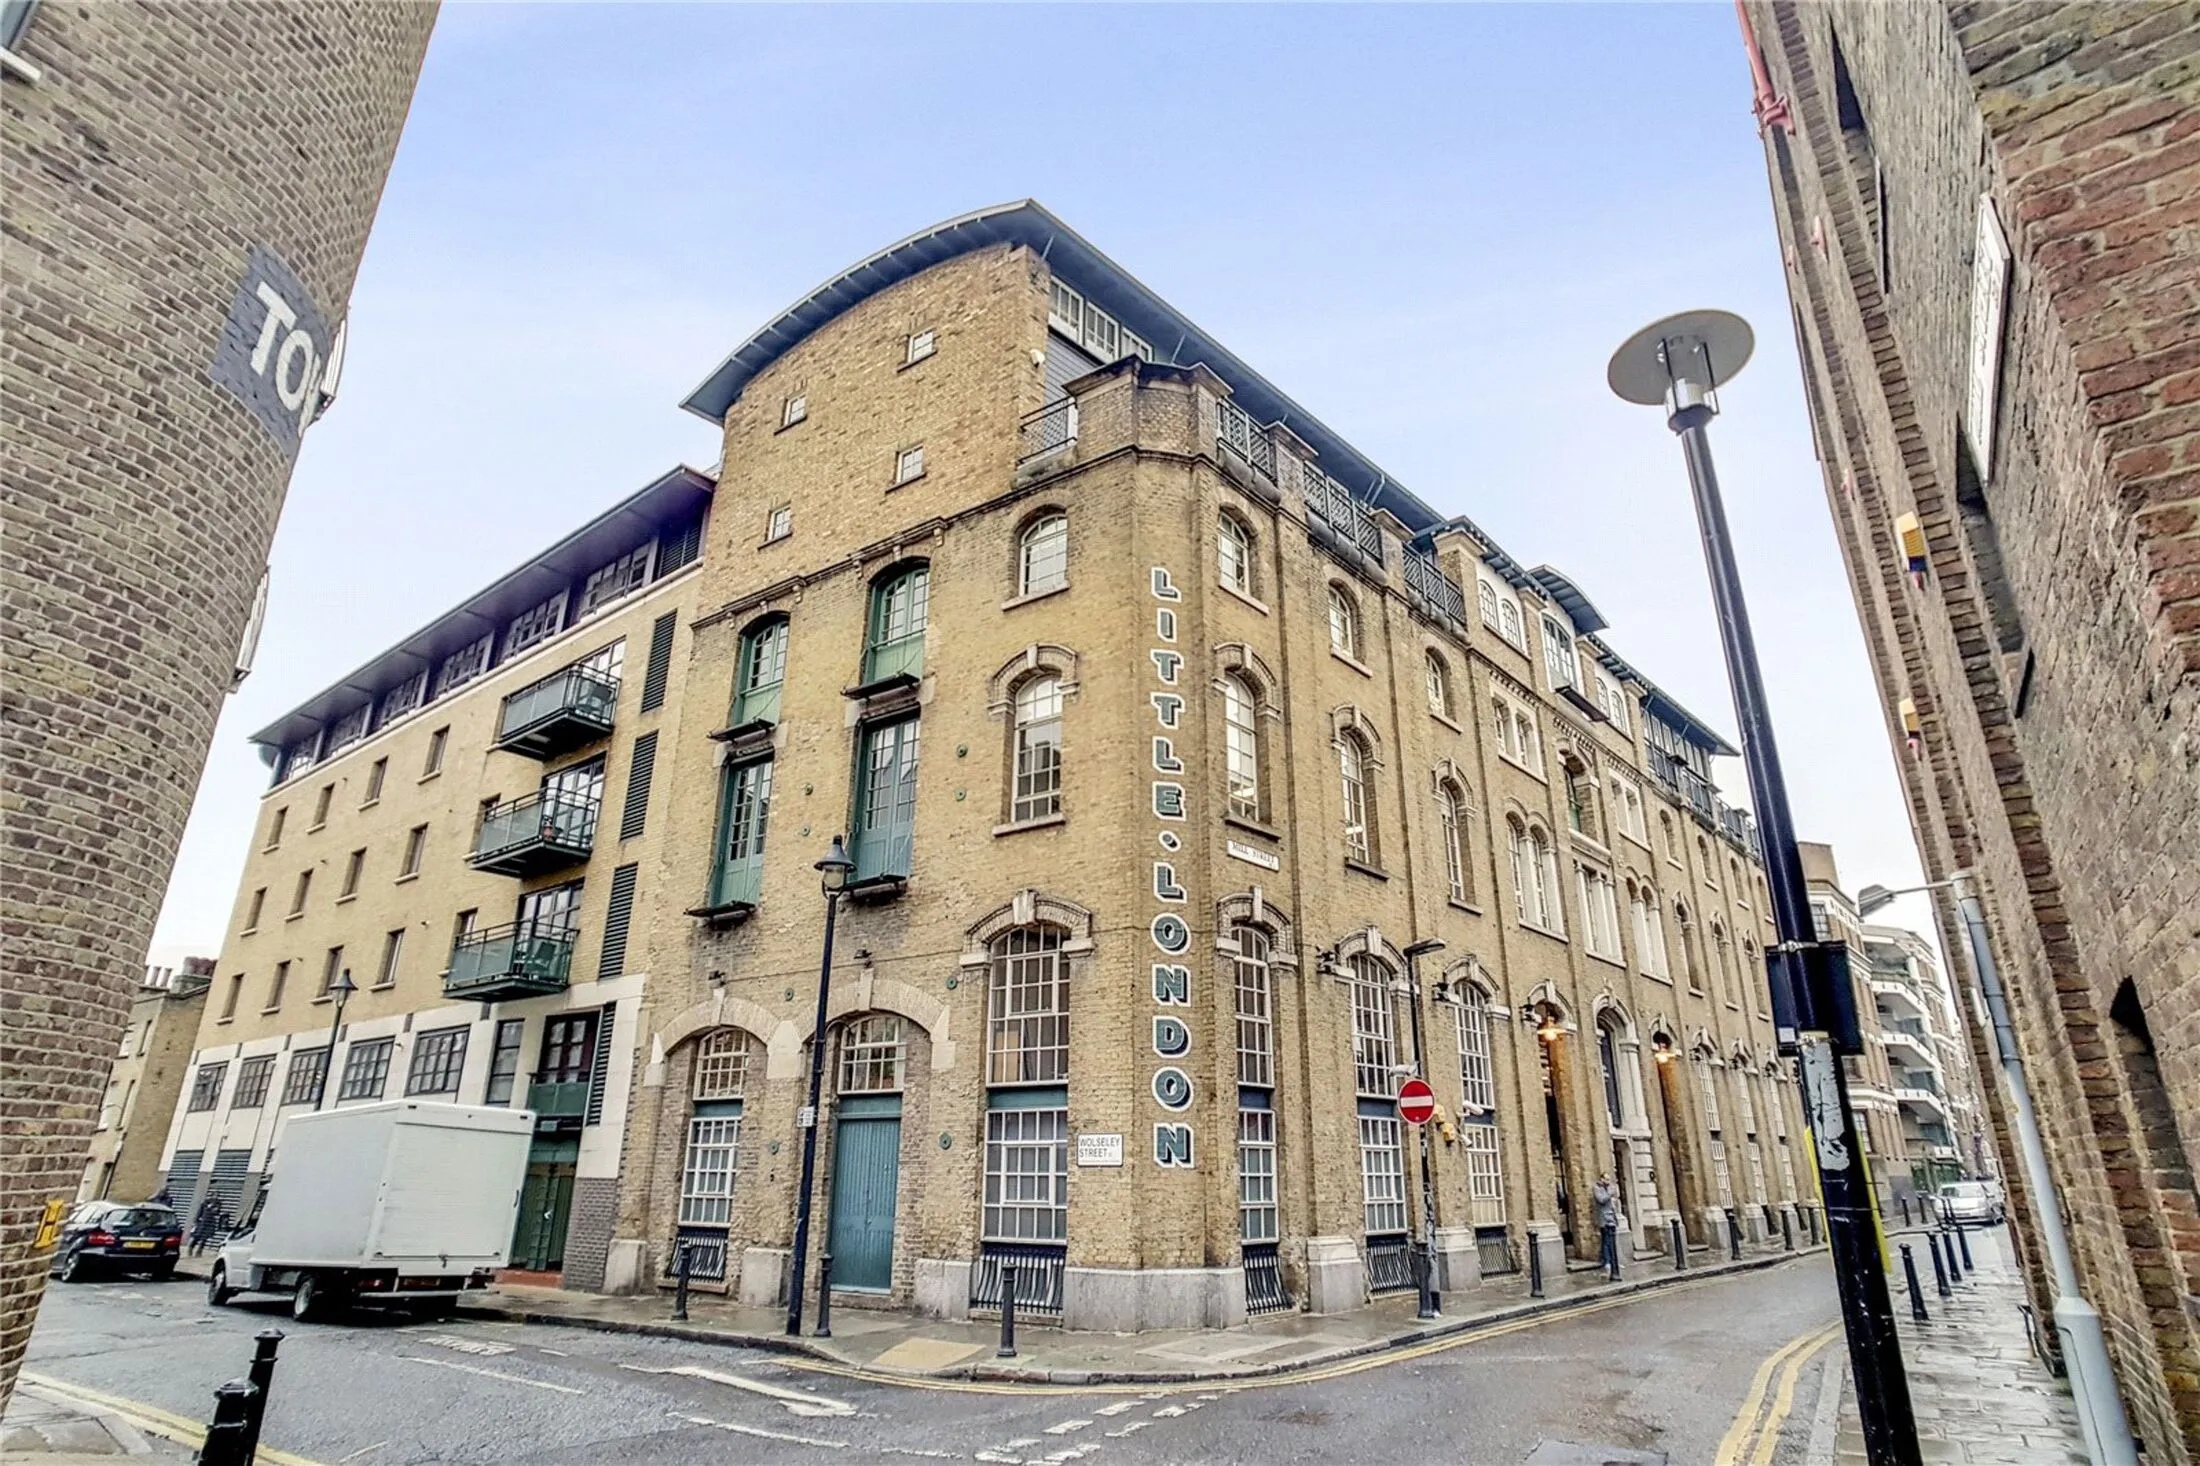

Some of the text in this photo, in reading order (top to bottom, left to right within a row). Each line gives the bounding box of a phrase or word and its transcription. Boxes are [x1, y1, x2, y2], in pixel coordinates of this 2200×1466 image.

[1151, 567, 1193, 1167] LITTLE LONDON
[1079, 1137, 1120, 1147] WOLSELEY
[1079, 1148, 1107, 1157] STREET
